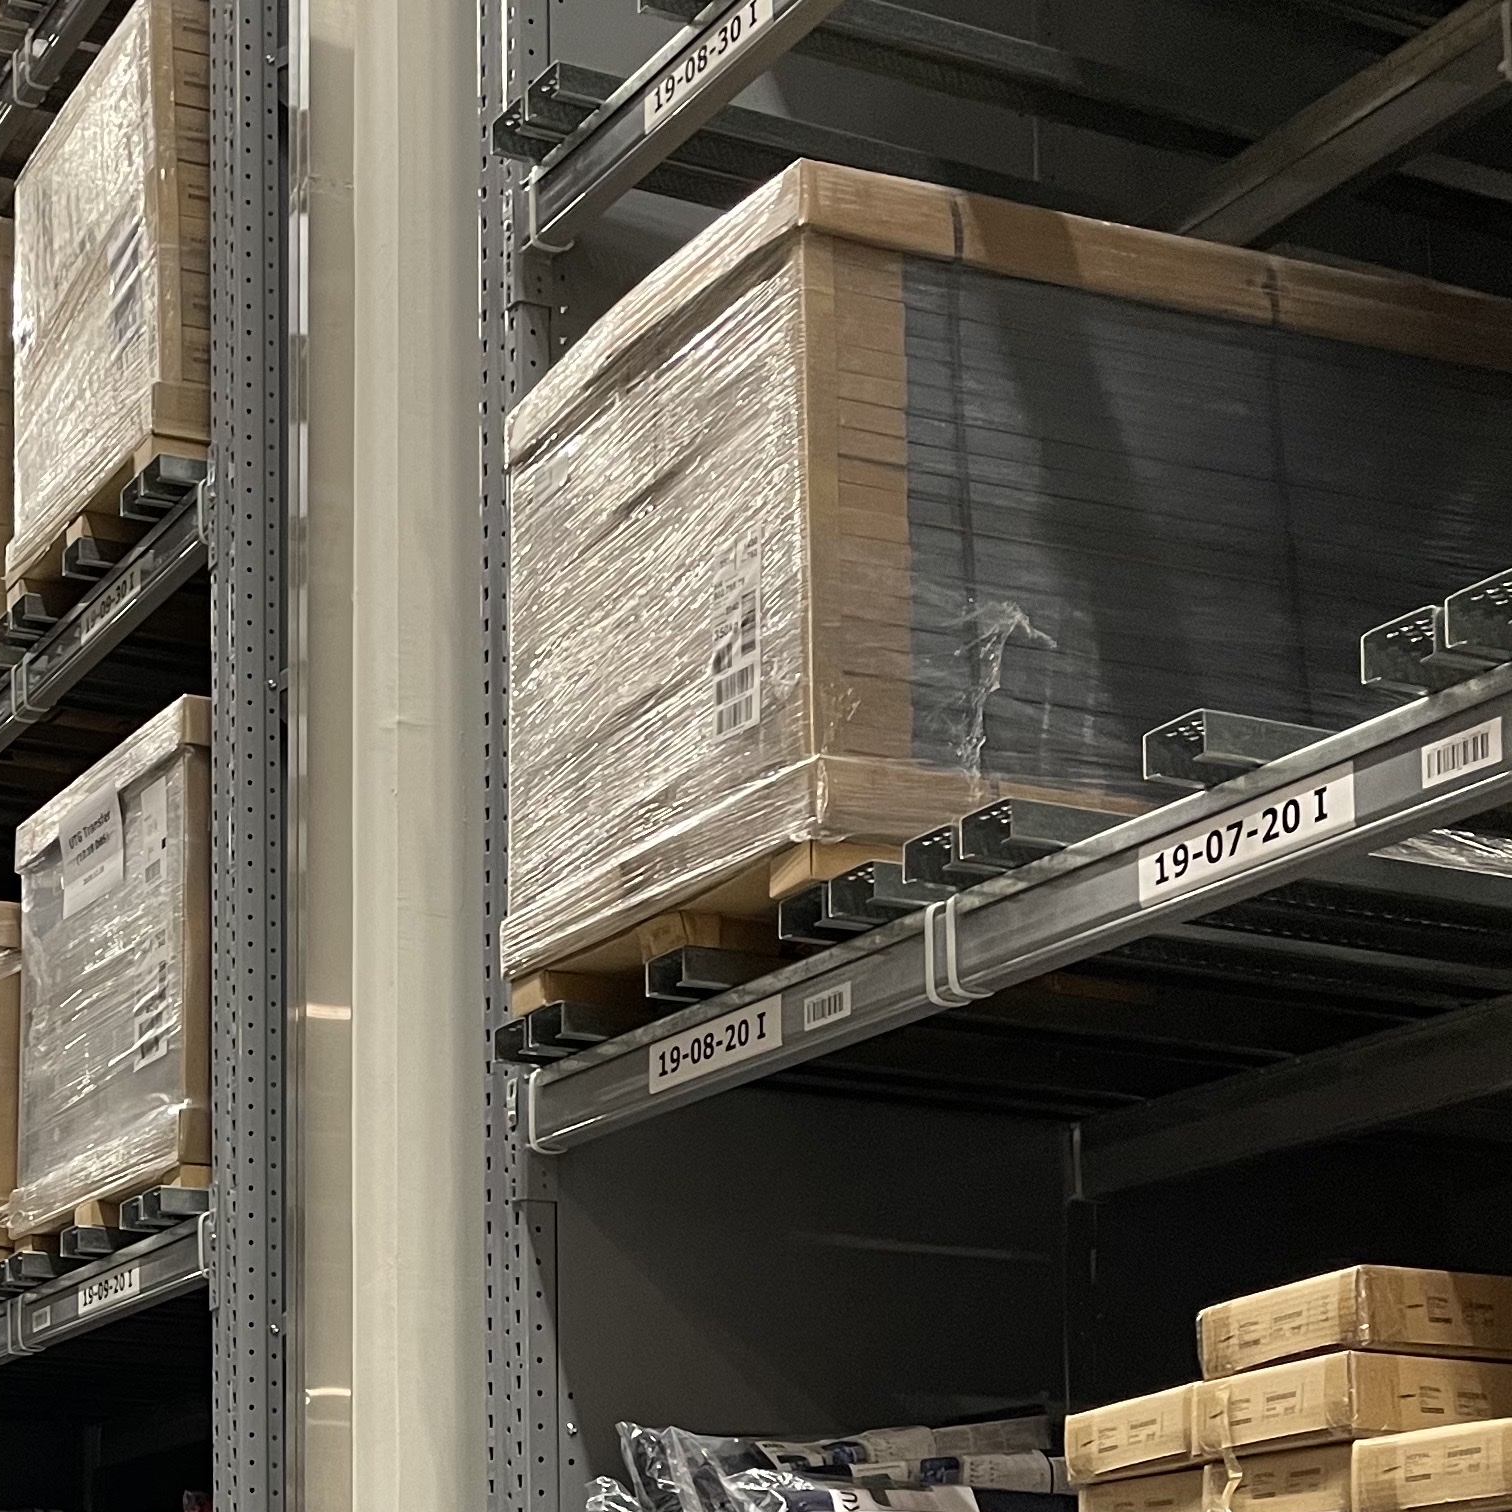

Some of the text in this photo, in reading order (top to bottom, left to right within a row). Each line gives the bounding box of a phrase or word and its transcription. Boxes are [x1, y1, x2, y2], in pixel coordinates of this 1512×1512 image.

[654, 0, 757, 113] 19-08-30 I
[1155, 786, 1328, 885] 19-07-20 I
[658, 1011, 766, 1078] 19-08-20 I
[82, 1275, 126, 1307] 19-09-20
